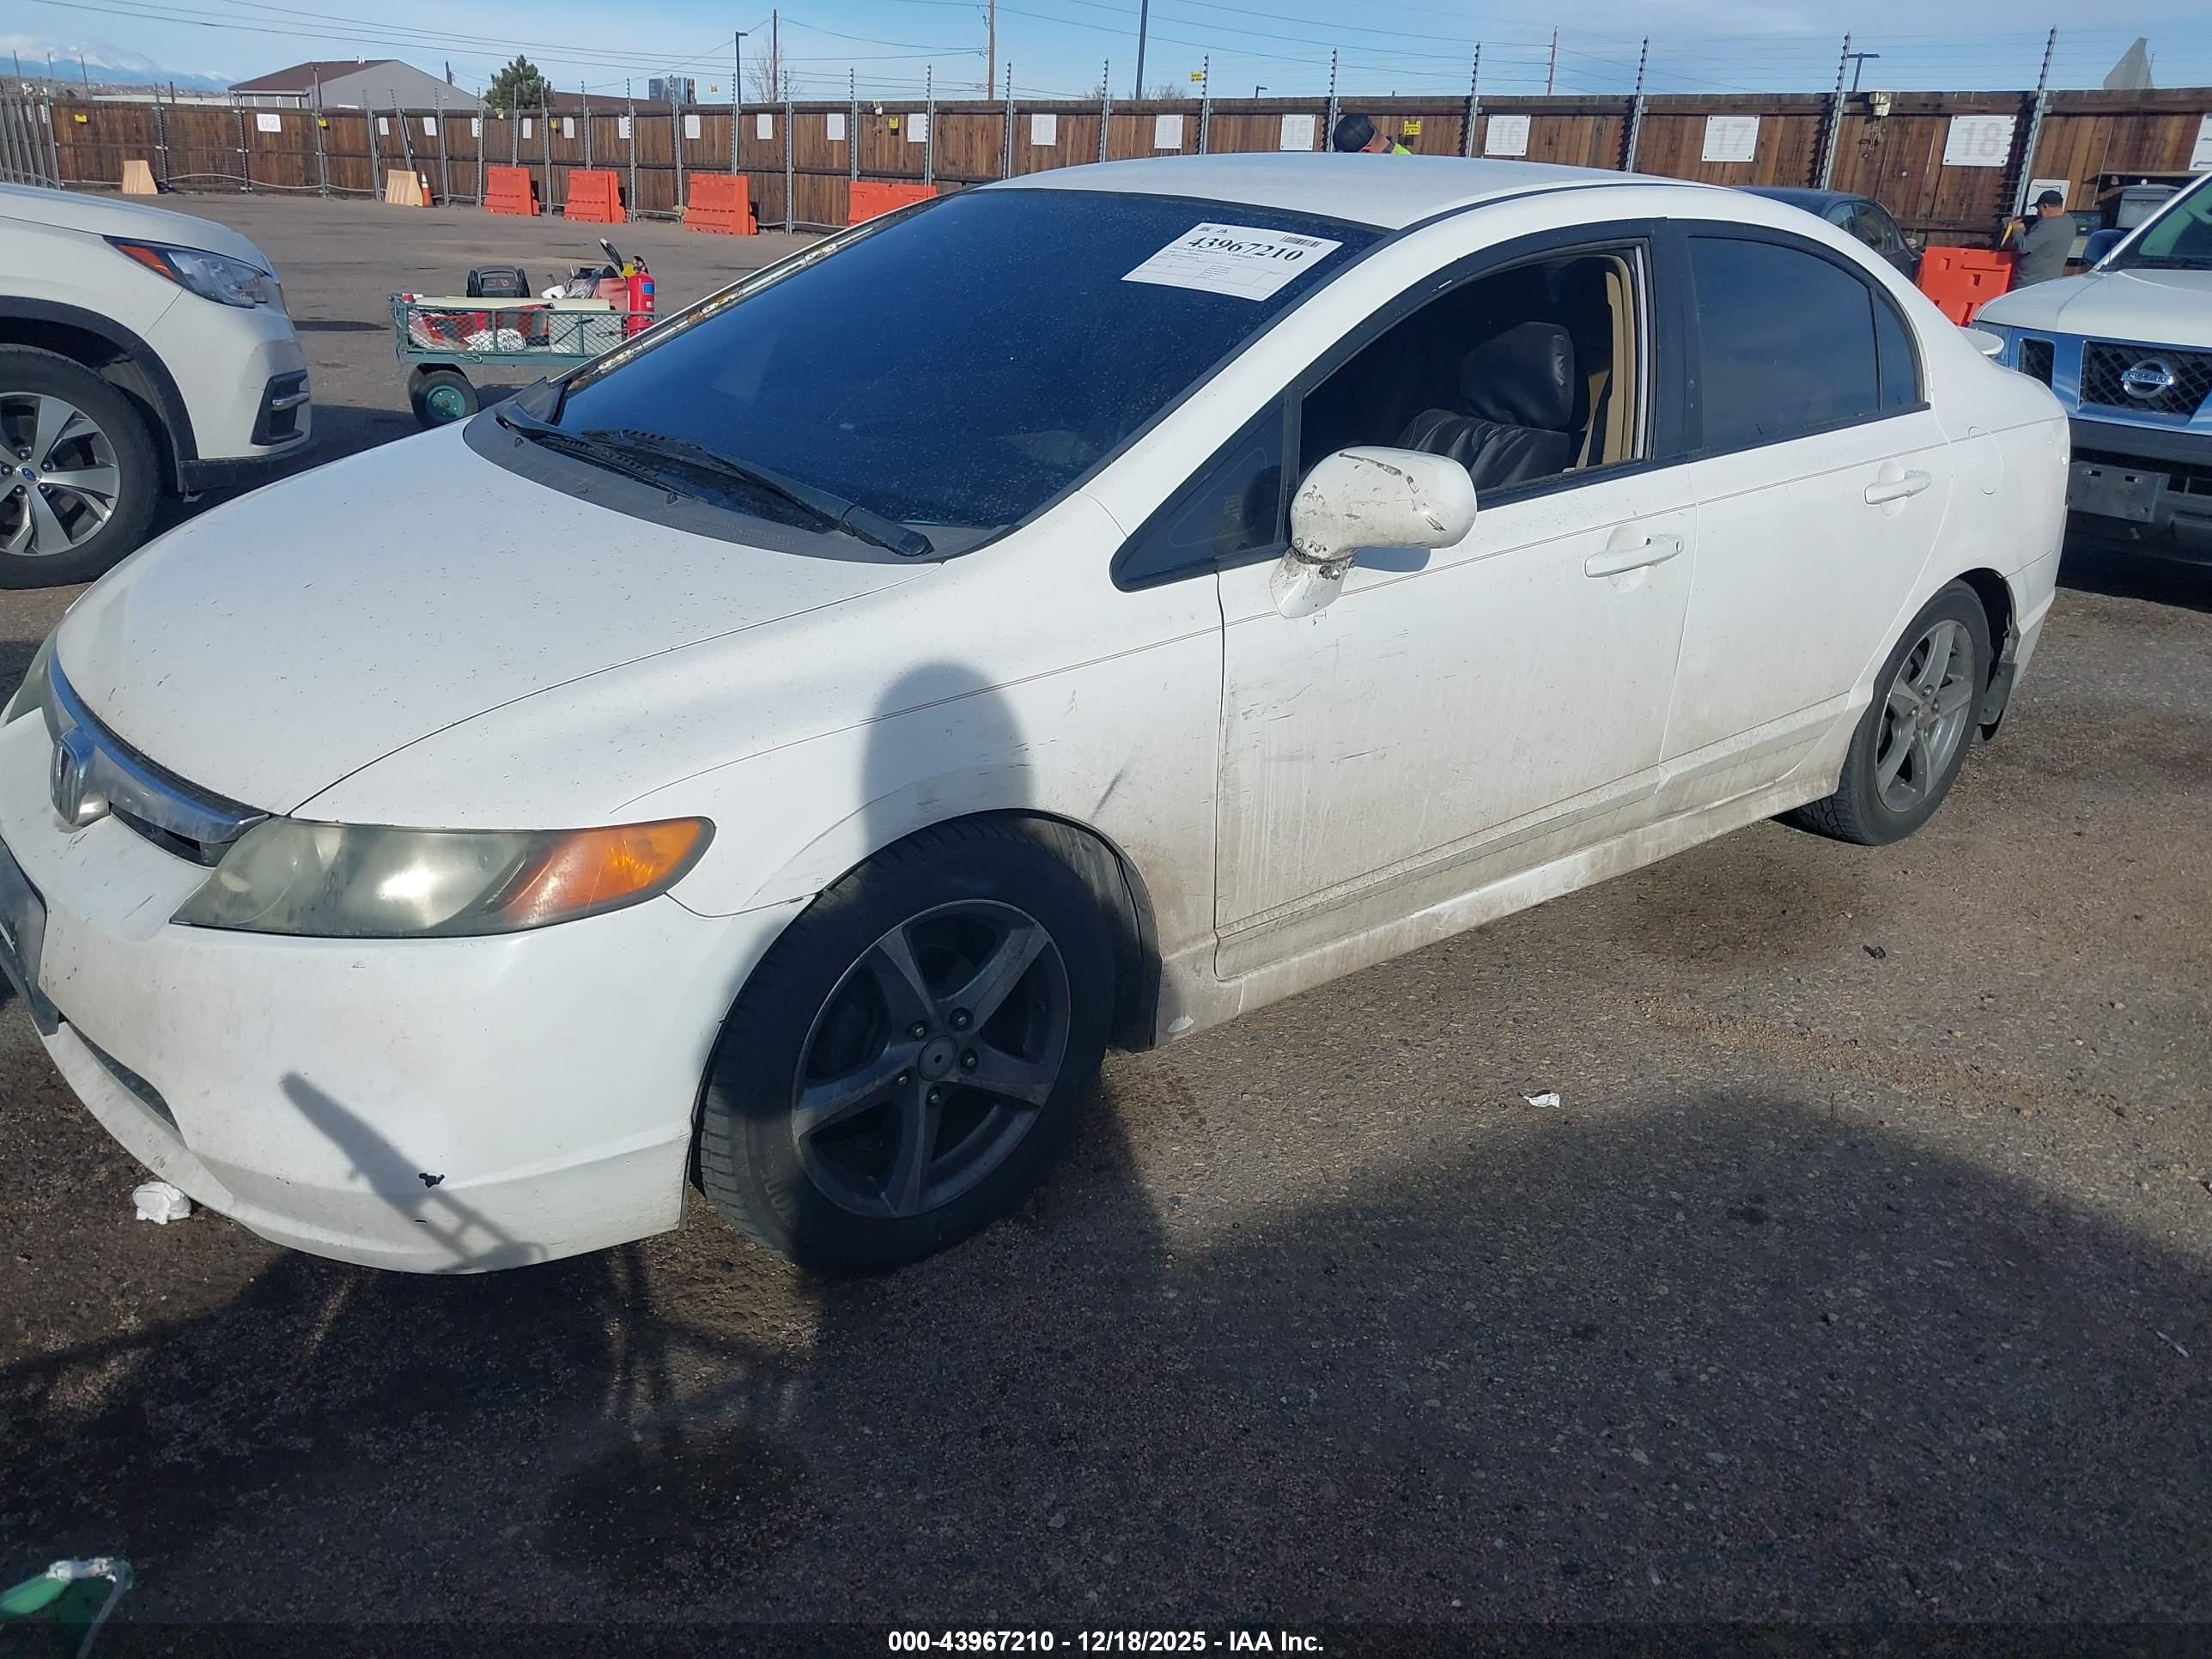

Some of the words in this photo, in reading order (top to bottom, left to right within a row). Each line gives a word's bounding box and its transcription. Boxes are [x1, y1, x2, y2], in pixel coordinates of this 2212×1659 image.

[261, 116, 278, 130] 02
[1286, 119, 1310, 145] 15
[1494, 121, 1521, 149] 16
[1714, 122, 1750, 155] 17
[1960, 122, 2002, 158] 18
[1188, 236, 1304, 261] 43967210
